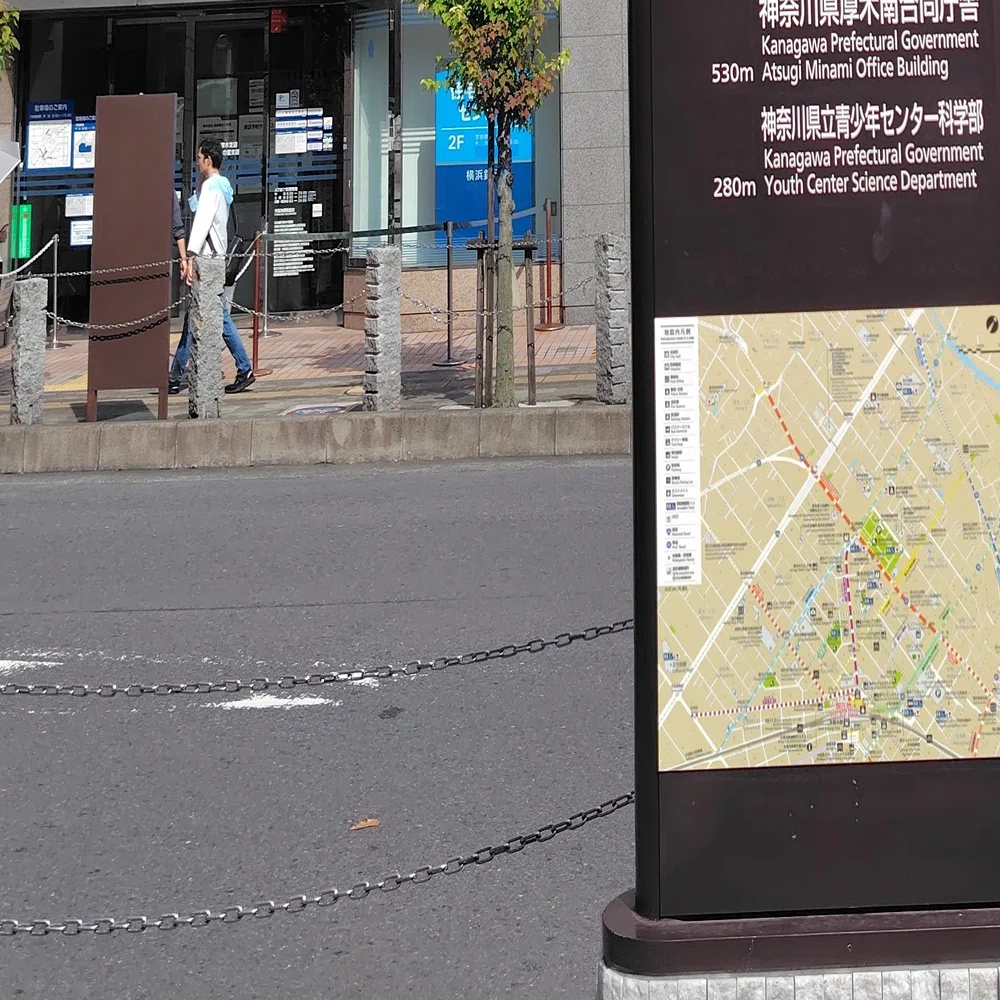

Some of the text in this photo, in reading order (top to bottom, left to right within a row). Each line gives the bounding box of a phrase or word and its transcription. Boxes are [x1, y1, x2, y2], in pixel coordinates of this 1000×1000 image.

[761, 29, 980, 60] Kanagawa Prefectural Government
[711, 54, 949, 86] 530m Atsugi Minami Office Building
[760, 98, 985, 143] 神奈川県立青少年センター科学部
[448, 134, 465, 150] 2F
[764, 141, 985, 173] Kanagawa Prefectural Government
[466, 168, 497, 182] 横浜
[713, 168, 978, 198] 280m Youth Center Science Department
